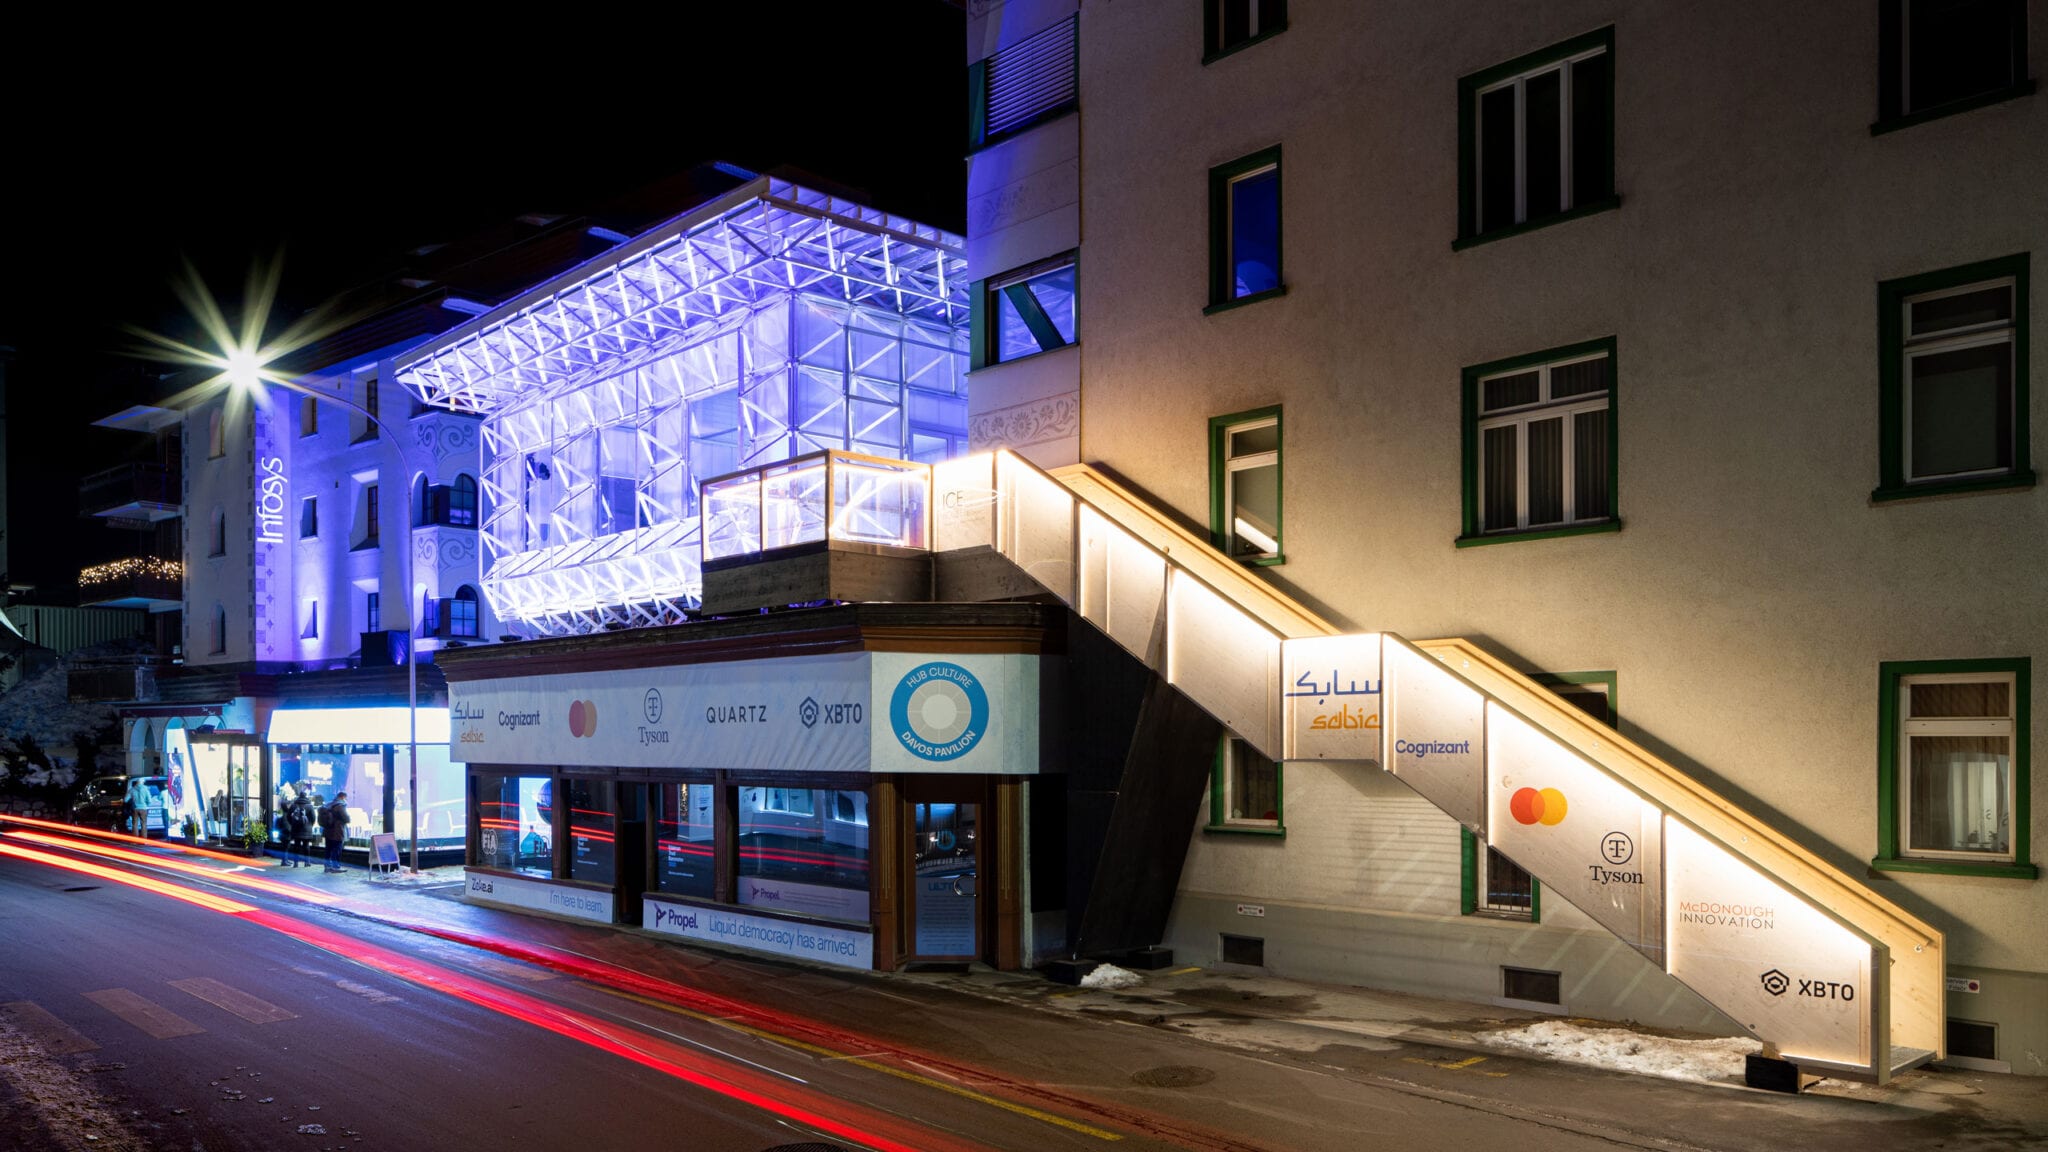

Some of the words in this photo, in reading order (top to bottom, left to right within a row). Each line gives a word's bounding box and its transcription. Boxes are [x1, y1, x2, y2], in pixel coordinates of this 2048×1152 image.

[256, 457, 288, 543] Infosys
[943, 490, 964, 509] ICE
[906, 670, 928, 688] HUB
[929, 667, 973, 689] CULTURE
[498, 710, 541, 731] Cognizant
[706, 705, 768, 724] QUARTZ
[824, 703, 862, 725] XBTO
[1309, 703, 1382, 730] sabic
[638, 727, 669, 746] Tyson
[901, 731, 933, 756] DAVOS
[934, 730, 976, 757] PAVILION
[1395, 739, 1470, 758] Cognizant
[1589, 865, 1645, 885] Tyson
[1680, 901, 1774, 918] McDONOUGH
[1679, 912, 1774, 930] INNOVATION
[669, 908, 699, 932] Propel.
[709, 915, 737, 938] Liquid
[738, 920, 795, 951] democracy
[796, 929, 815, 949] has
[817, 934, 858, 957] arrived.
[1799, 978, 1855, 1001] XBTO
